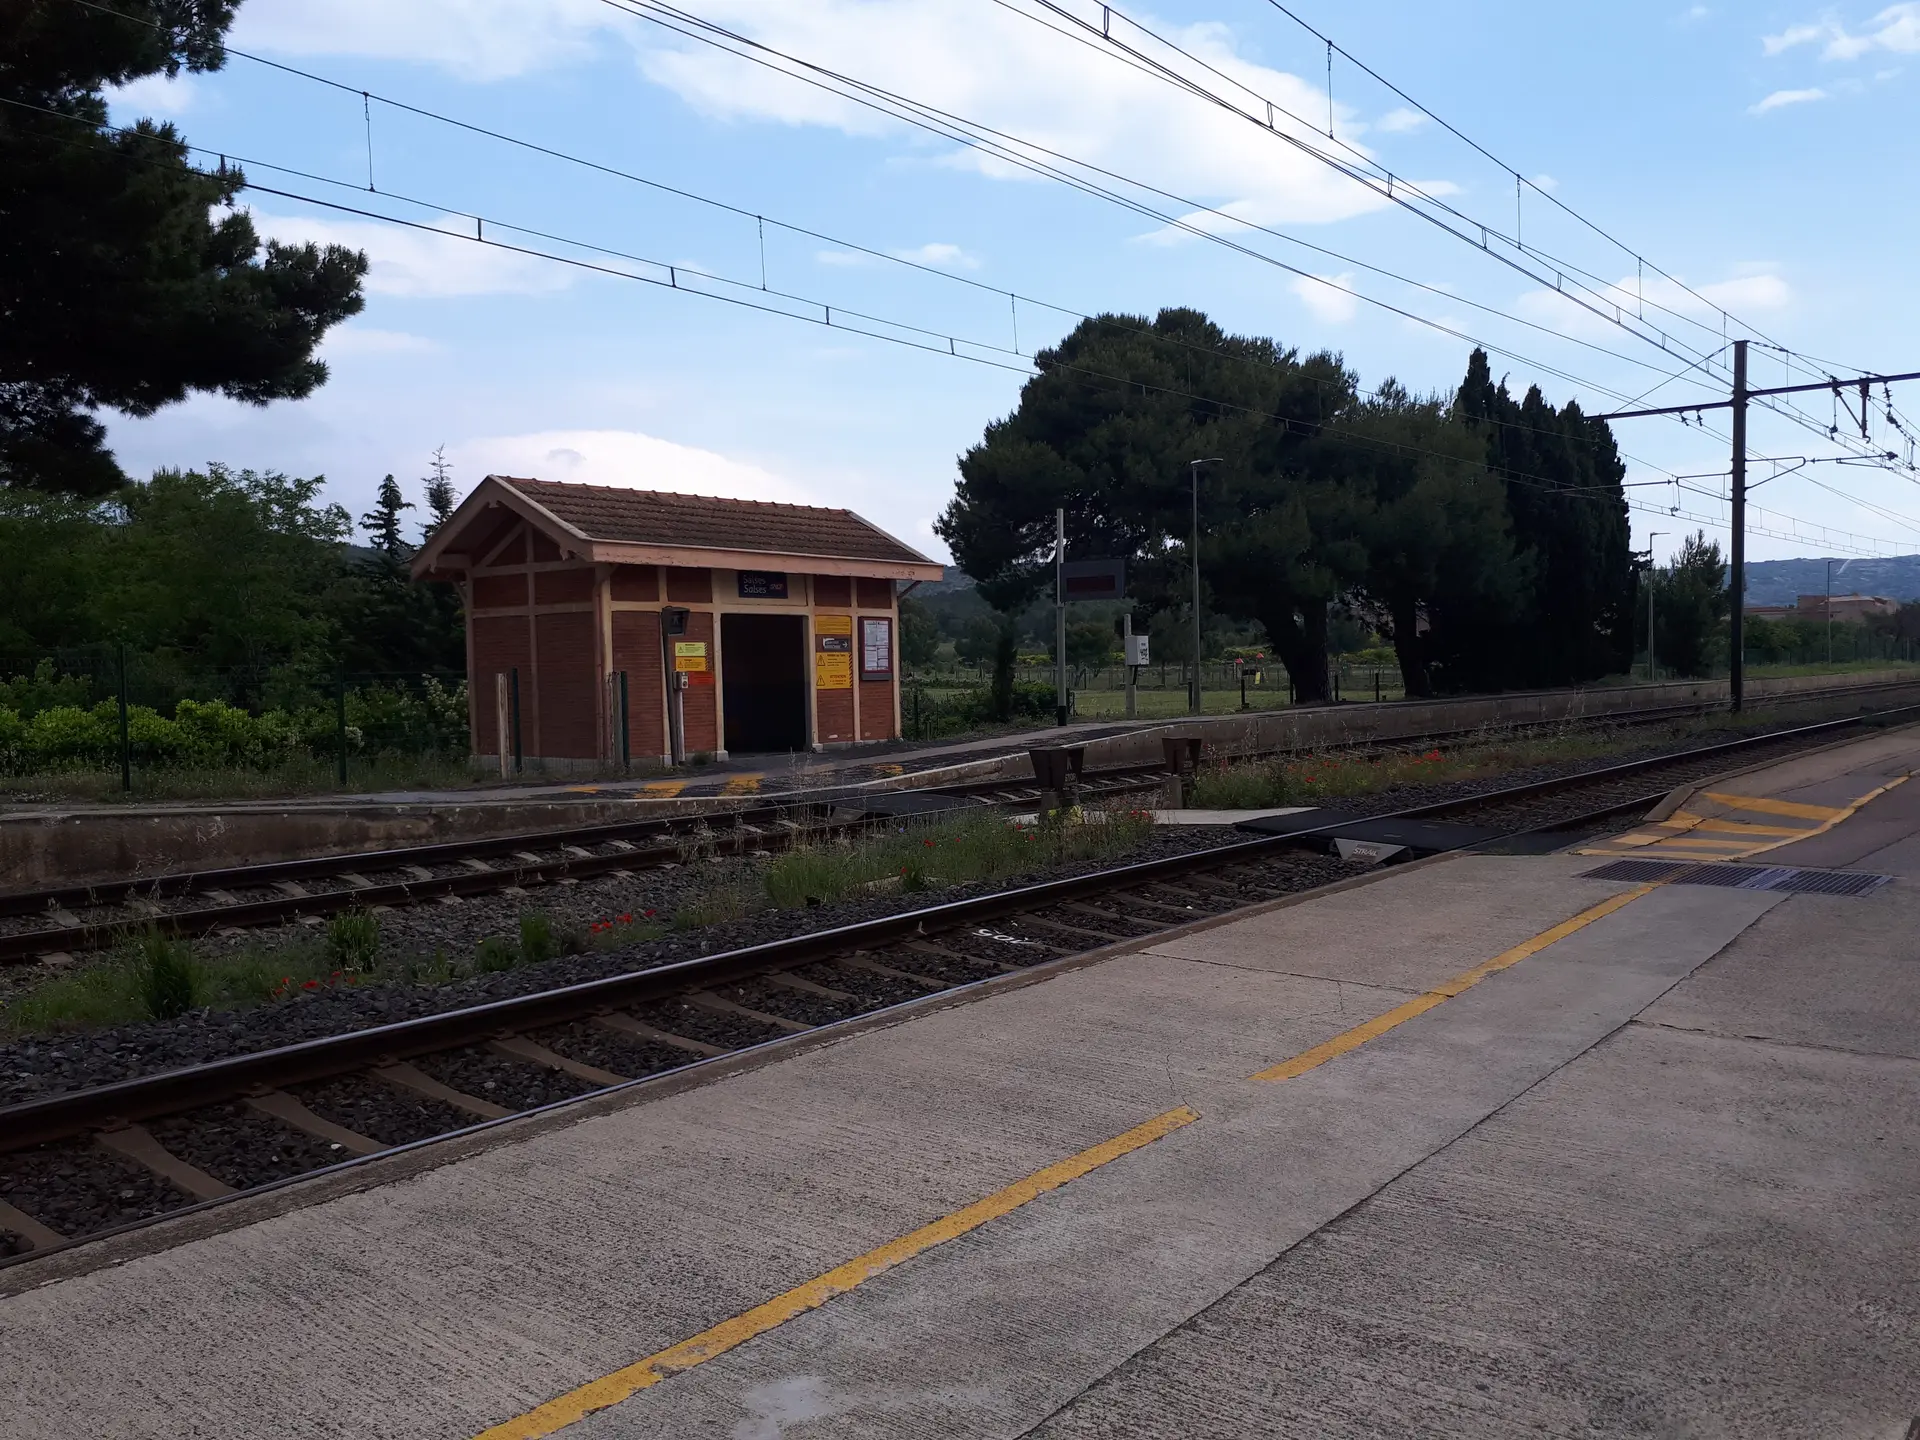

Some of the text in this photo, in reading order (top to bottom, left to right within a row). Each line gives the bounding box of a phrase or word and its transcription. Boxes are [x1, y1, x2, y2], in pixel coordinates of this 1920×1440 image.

[743, 575, 766, 585] Salses
[744, 584, 767, 594] Salses
[1352, 847, 1377, 857] STRAIL
